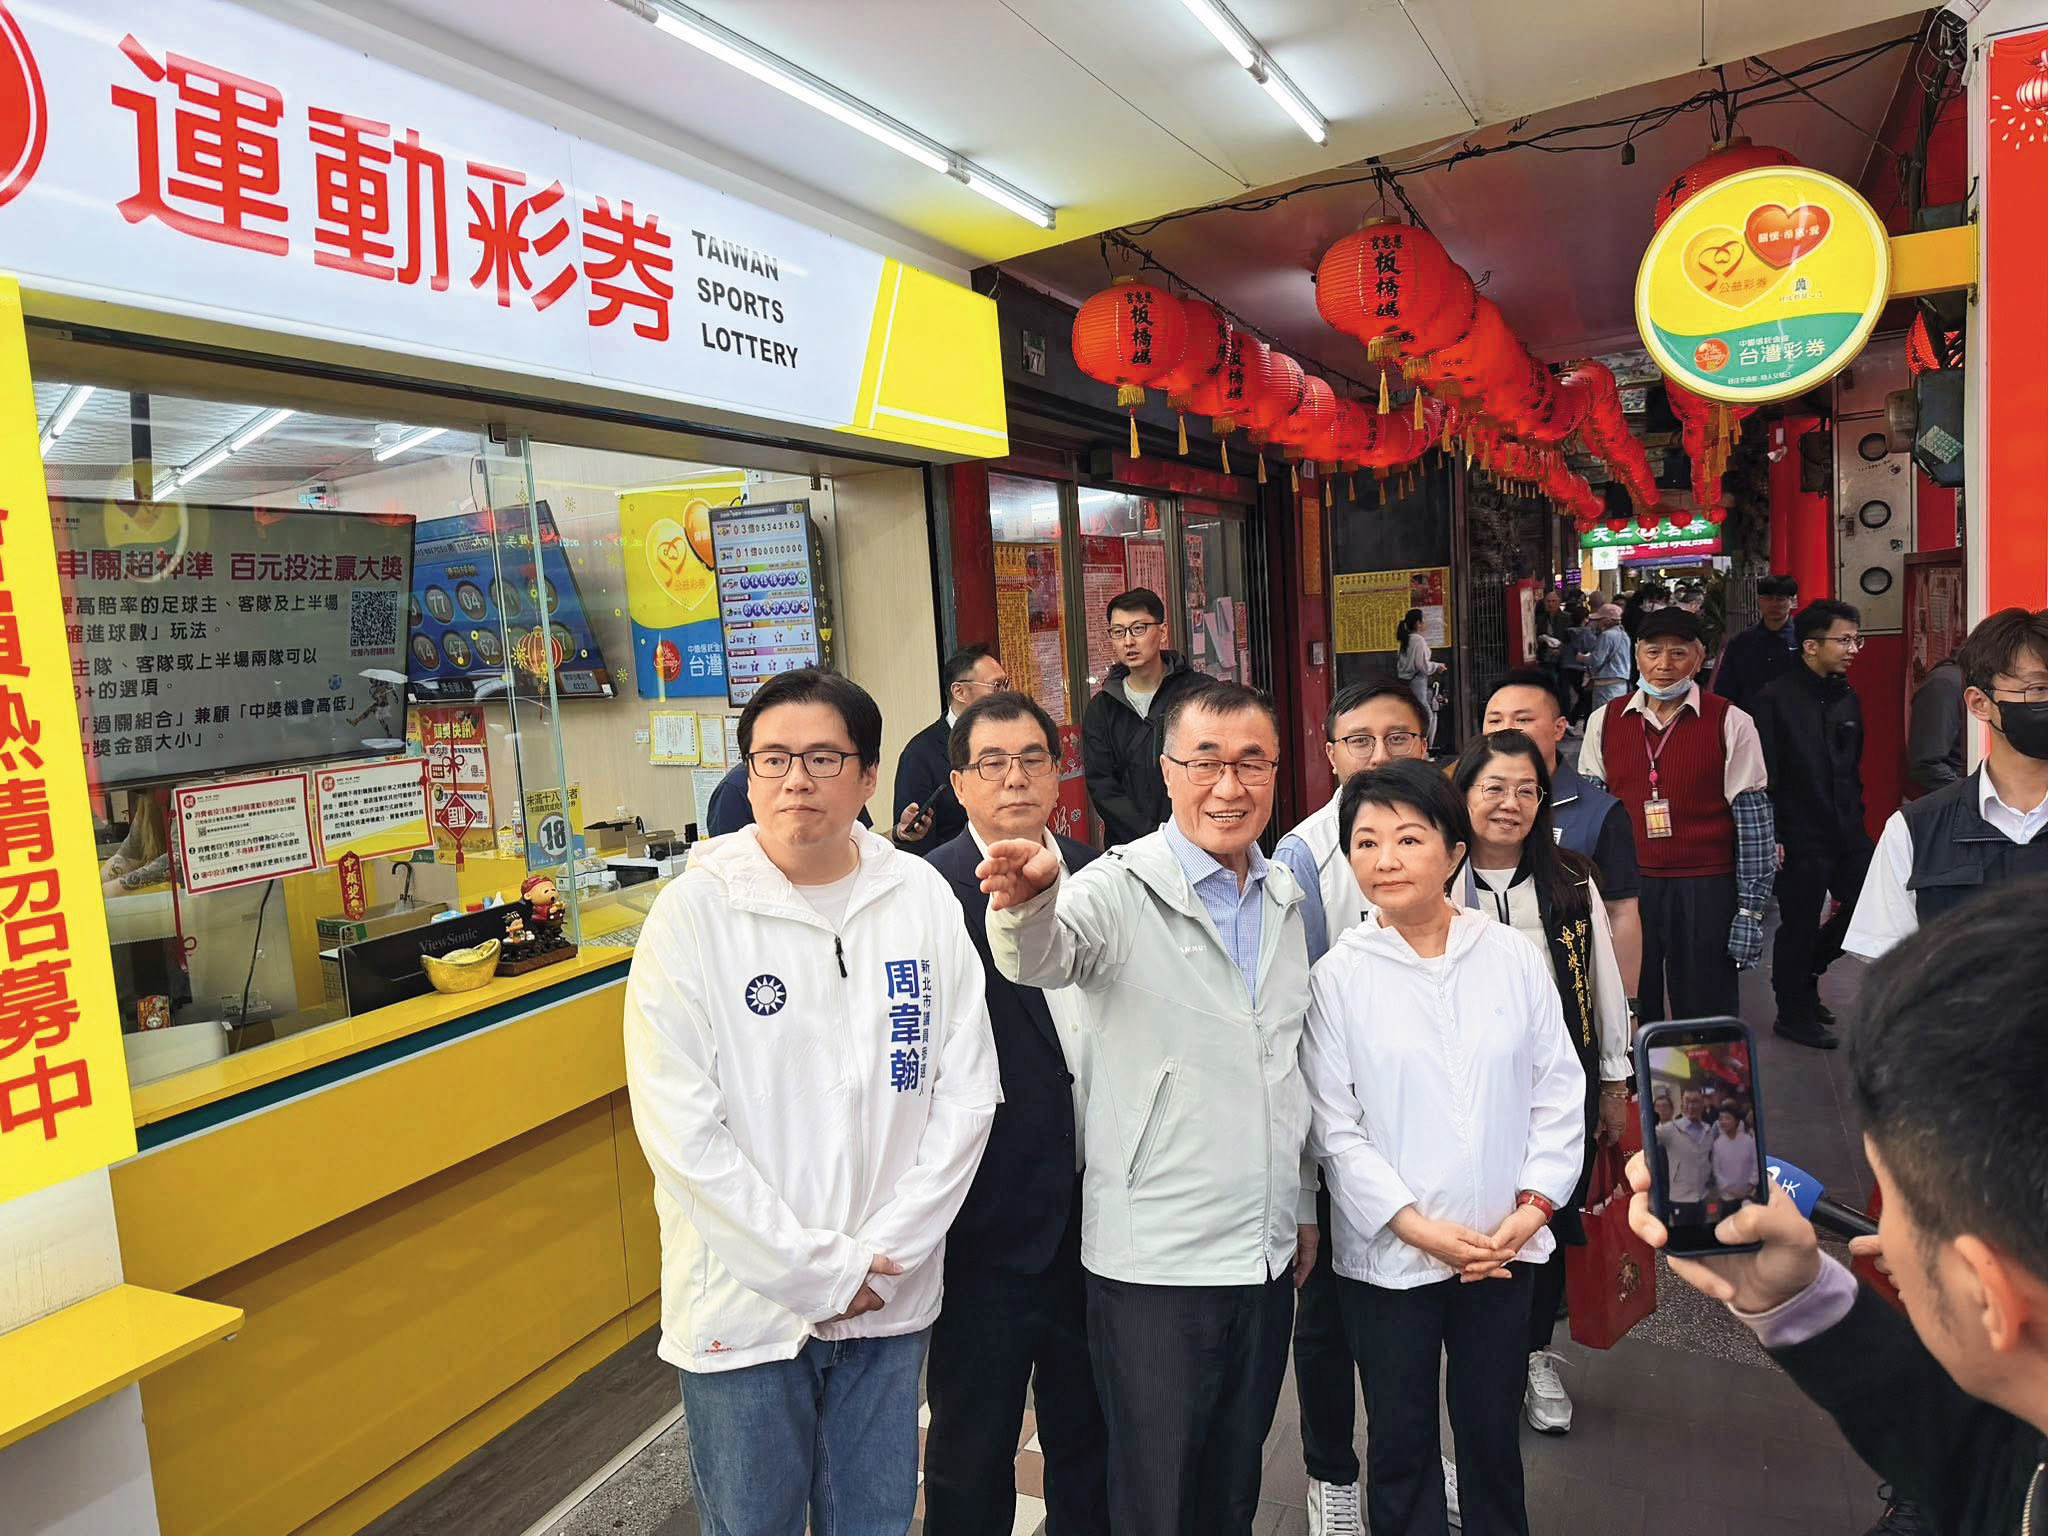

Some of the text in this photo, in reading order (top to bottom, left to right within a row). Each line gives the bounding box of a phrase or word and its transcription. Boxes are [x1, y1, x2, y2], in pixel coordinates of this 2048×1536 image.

[111, 33, 673, 343] 運動彩券
[691, 229, 779, 282] TAIWAN
[1375, 250, 1403, 317] 板橋媽
[1719, 276, 1768, 294] 公益彩券
[697, 277, 784, 324] SPORTS
[701, 322, 798, 369] LOTTERY
[1130, 304, 1153, 365] 板橋媽
[1739, 338, 1825, 367] 台灣彩券
[57, 549, 403, 582] 串關超神準 百元投注贏大獎
[429, 591, 480, 614] 77 04
[687, 642, 722, 654] 中國信託金
[689, 654, 723, 677] 台灣
[526, 787, 578, 807] 未滿十八者
[541, 820, 567, 851] 18
[419, 928, 479, 952] ViewSonic
[885, 959, 922, 1093] 周韋翰
